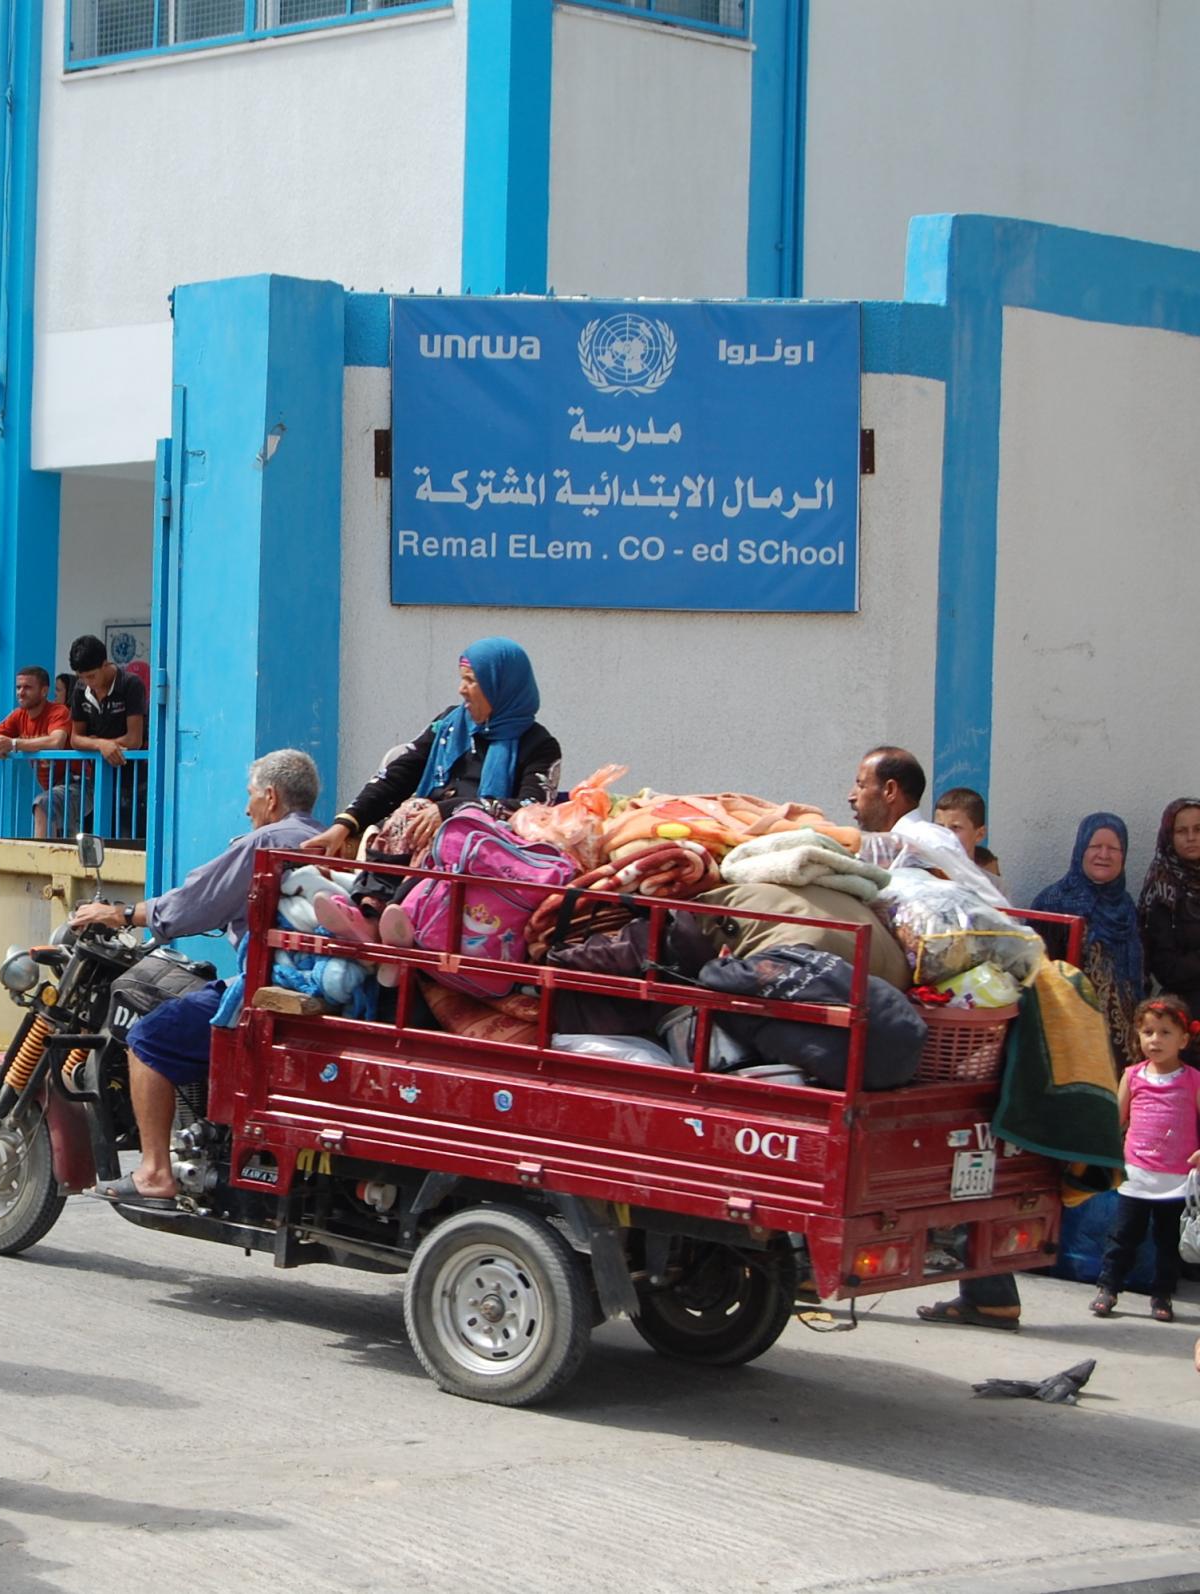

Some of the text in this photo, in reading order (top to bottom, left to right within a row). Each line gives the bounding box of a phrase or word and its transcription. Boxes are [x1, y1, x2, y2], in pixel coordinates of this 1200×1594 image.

[419, 333, 541, 360] unrwa
[568, 405, 682, 453] مدرسة
[413, 465, 834, 520] الرمال الابتدائية المشتركة
[398, 530, 497, 559] Remal
